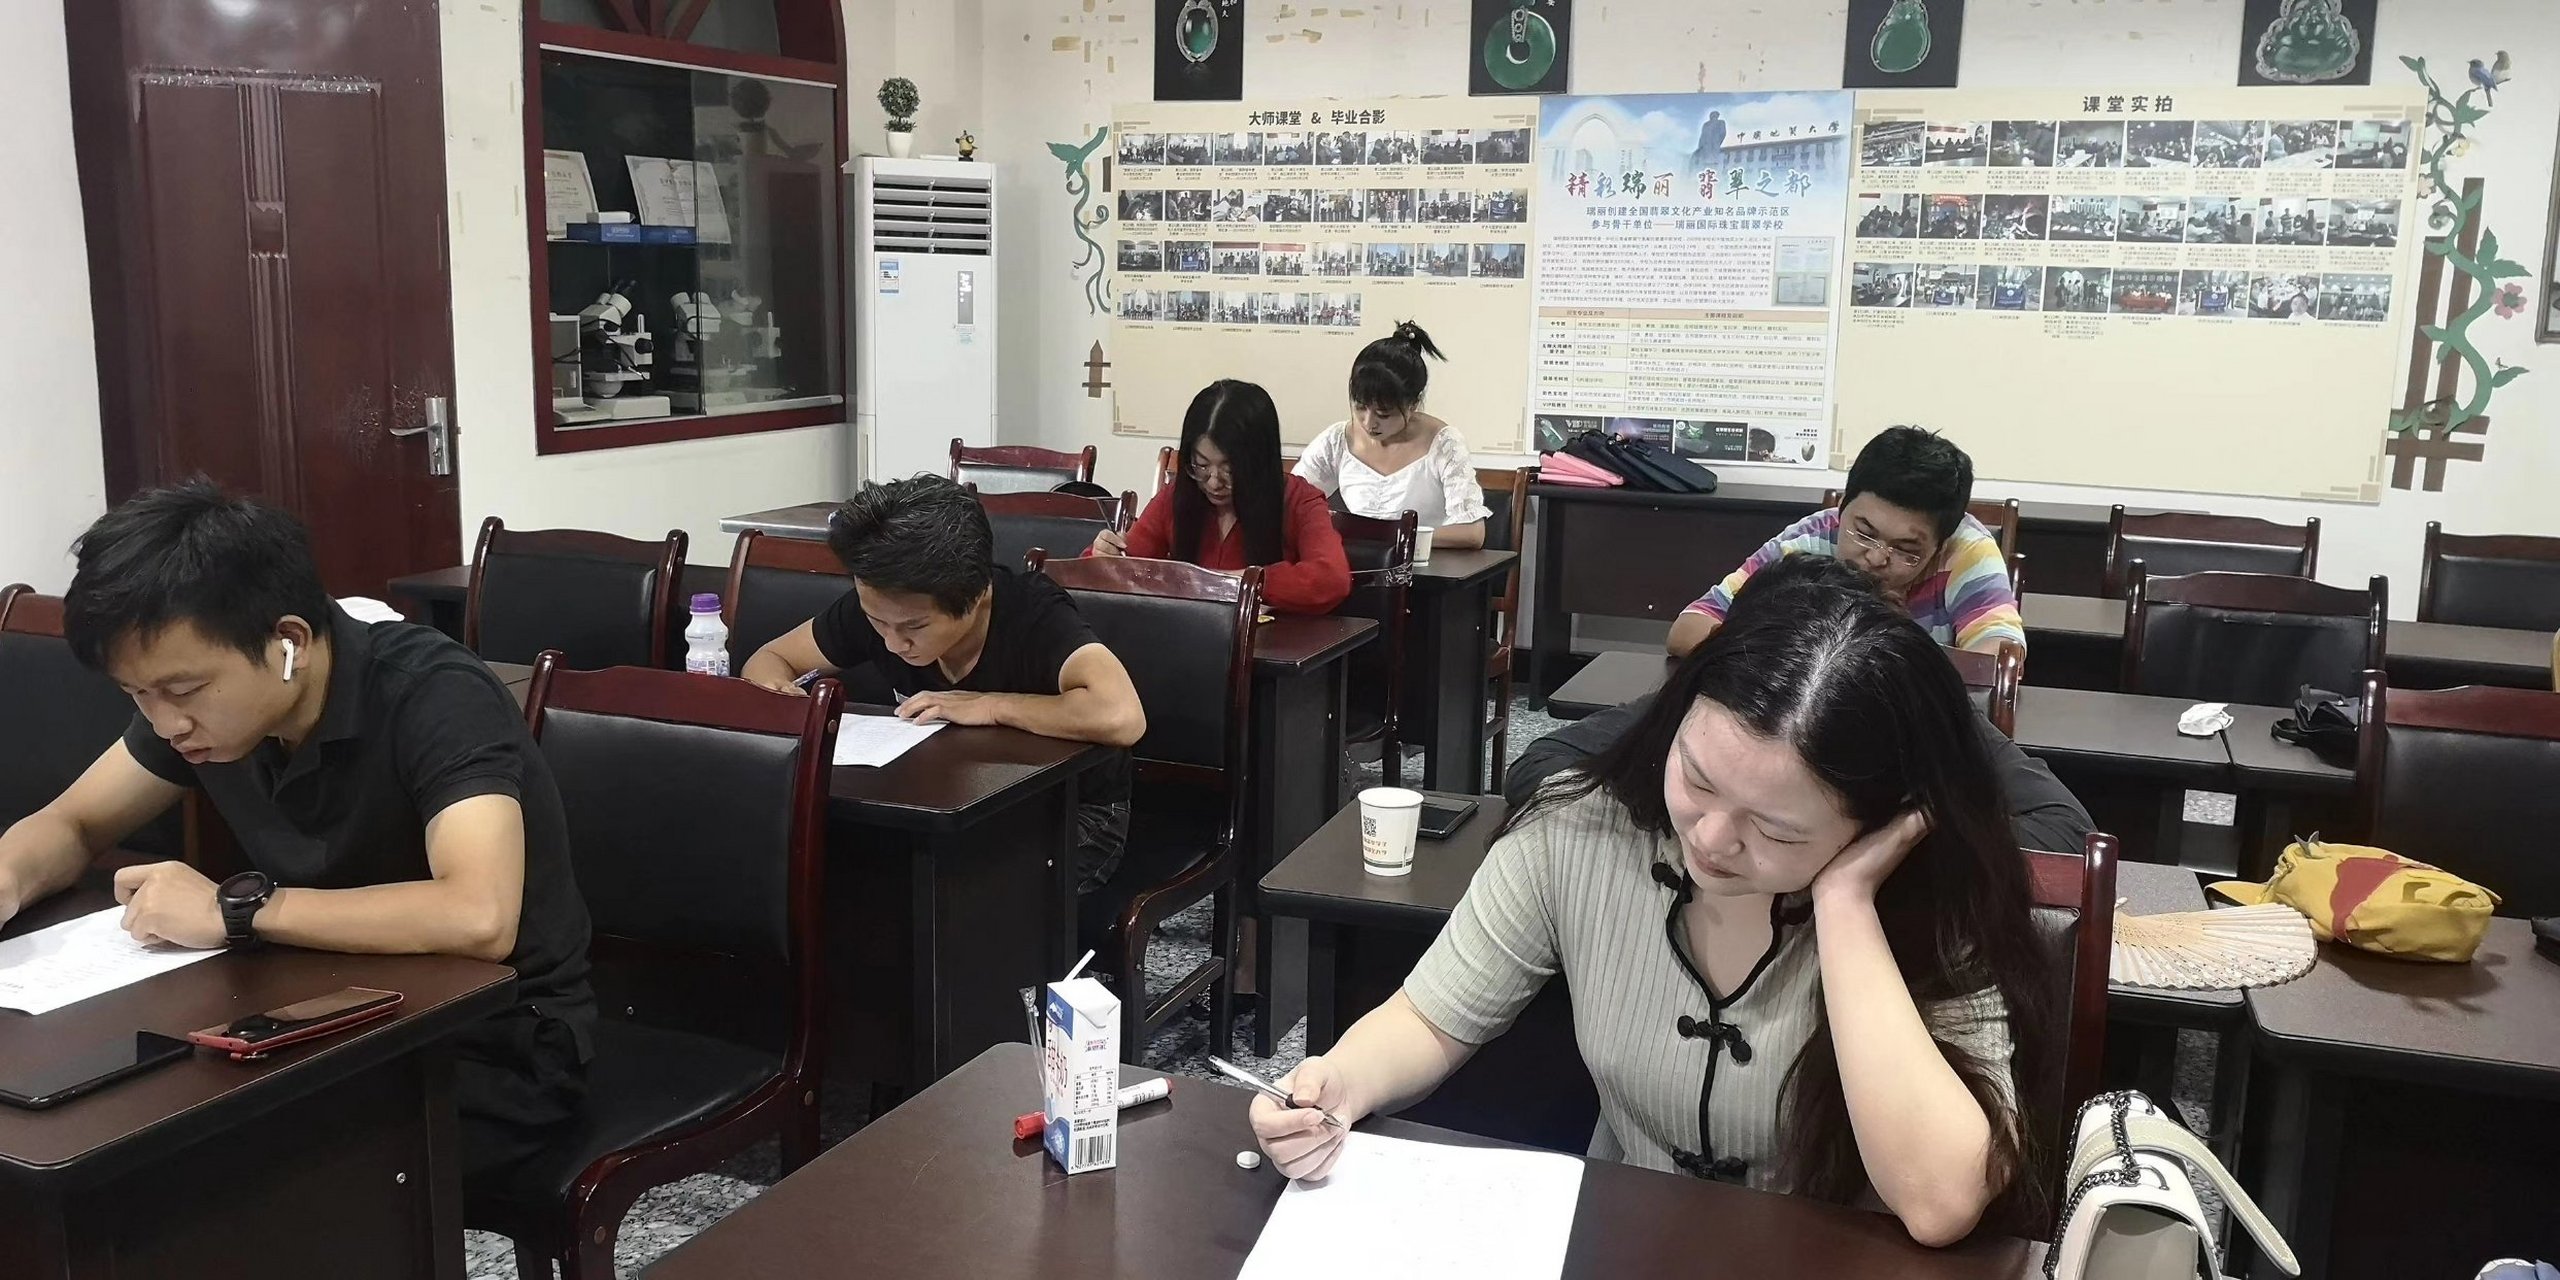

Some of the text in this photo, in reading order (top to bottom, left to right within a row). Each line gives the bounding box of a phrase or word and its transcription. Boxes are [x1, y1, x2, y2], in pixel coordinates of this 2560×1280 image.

[2082, 95, 2174, 113] 课堂实拍
[1248, 109, 1386, 127] 大师课堂 & 毕业合影
[1564, 168, 1812, 200] 精彩瑞丽 翡翠之都
[1586, 206, 1790, 217] 瑞丽创建全国翡翠文化产业知名品牌示范区
